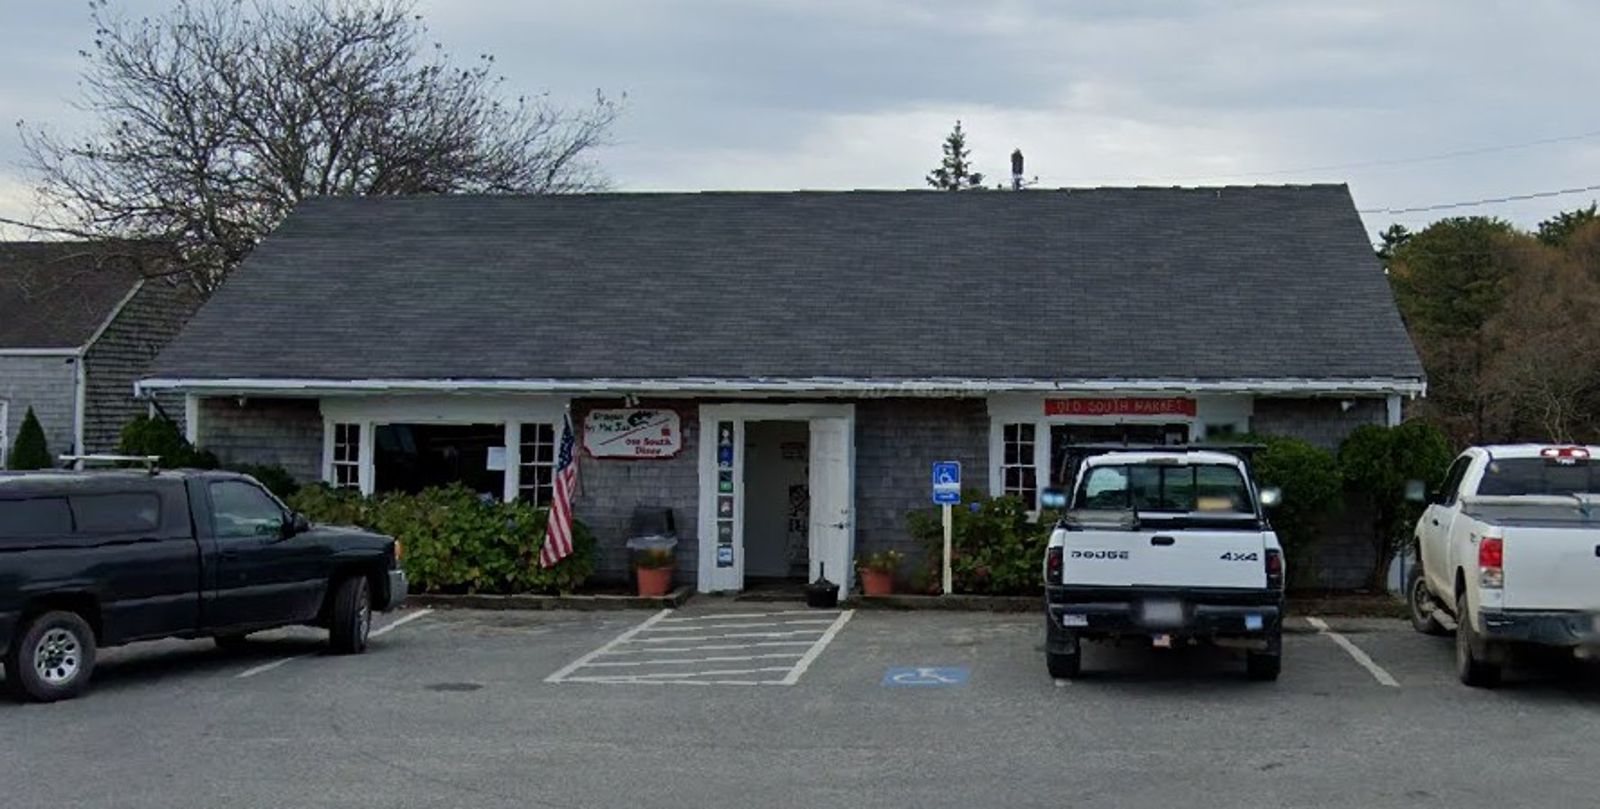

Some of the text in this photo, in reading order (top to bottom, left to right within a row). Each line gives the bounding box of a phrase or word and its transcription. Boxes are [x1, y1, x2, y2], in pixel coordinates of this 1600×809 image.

[1056, 399, 1184, 412] OLD SOUTH MARKET
[1071, 550, 1130, 561] DODGE
